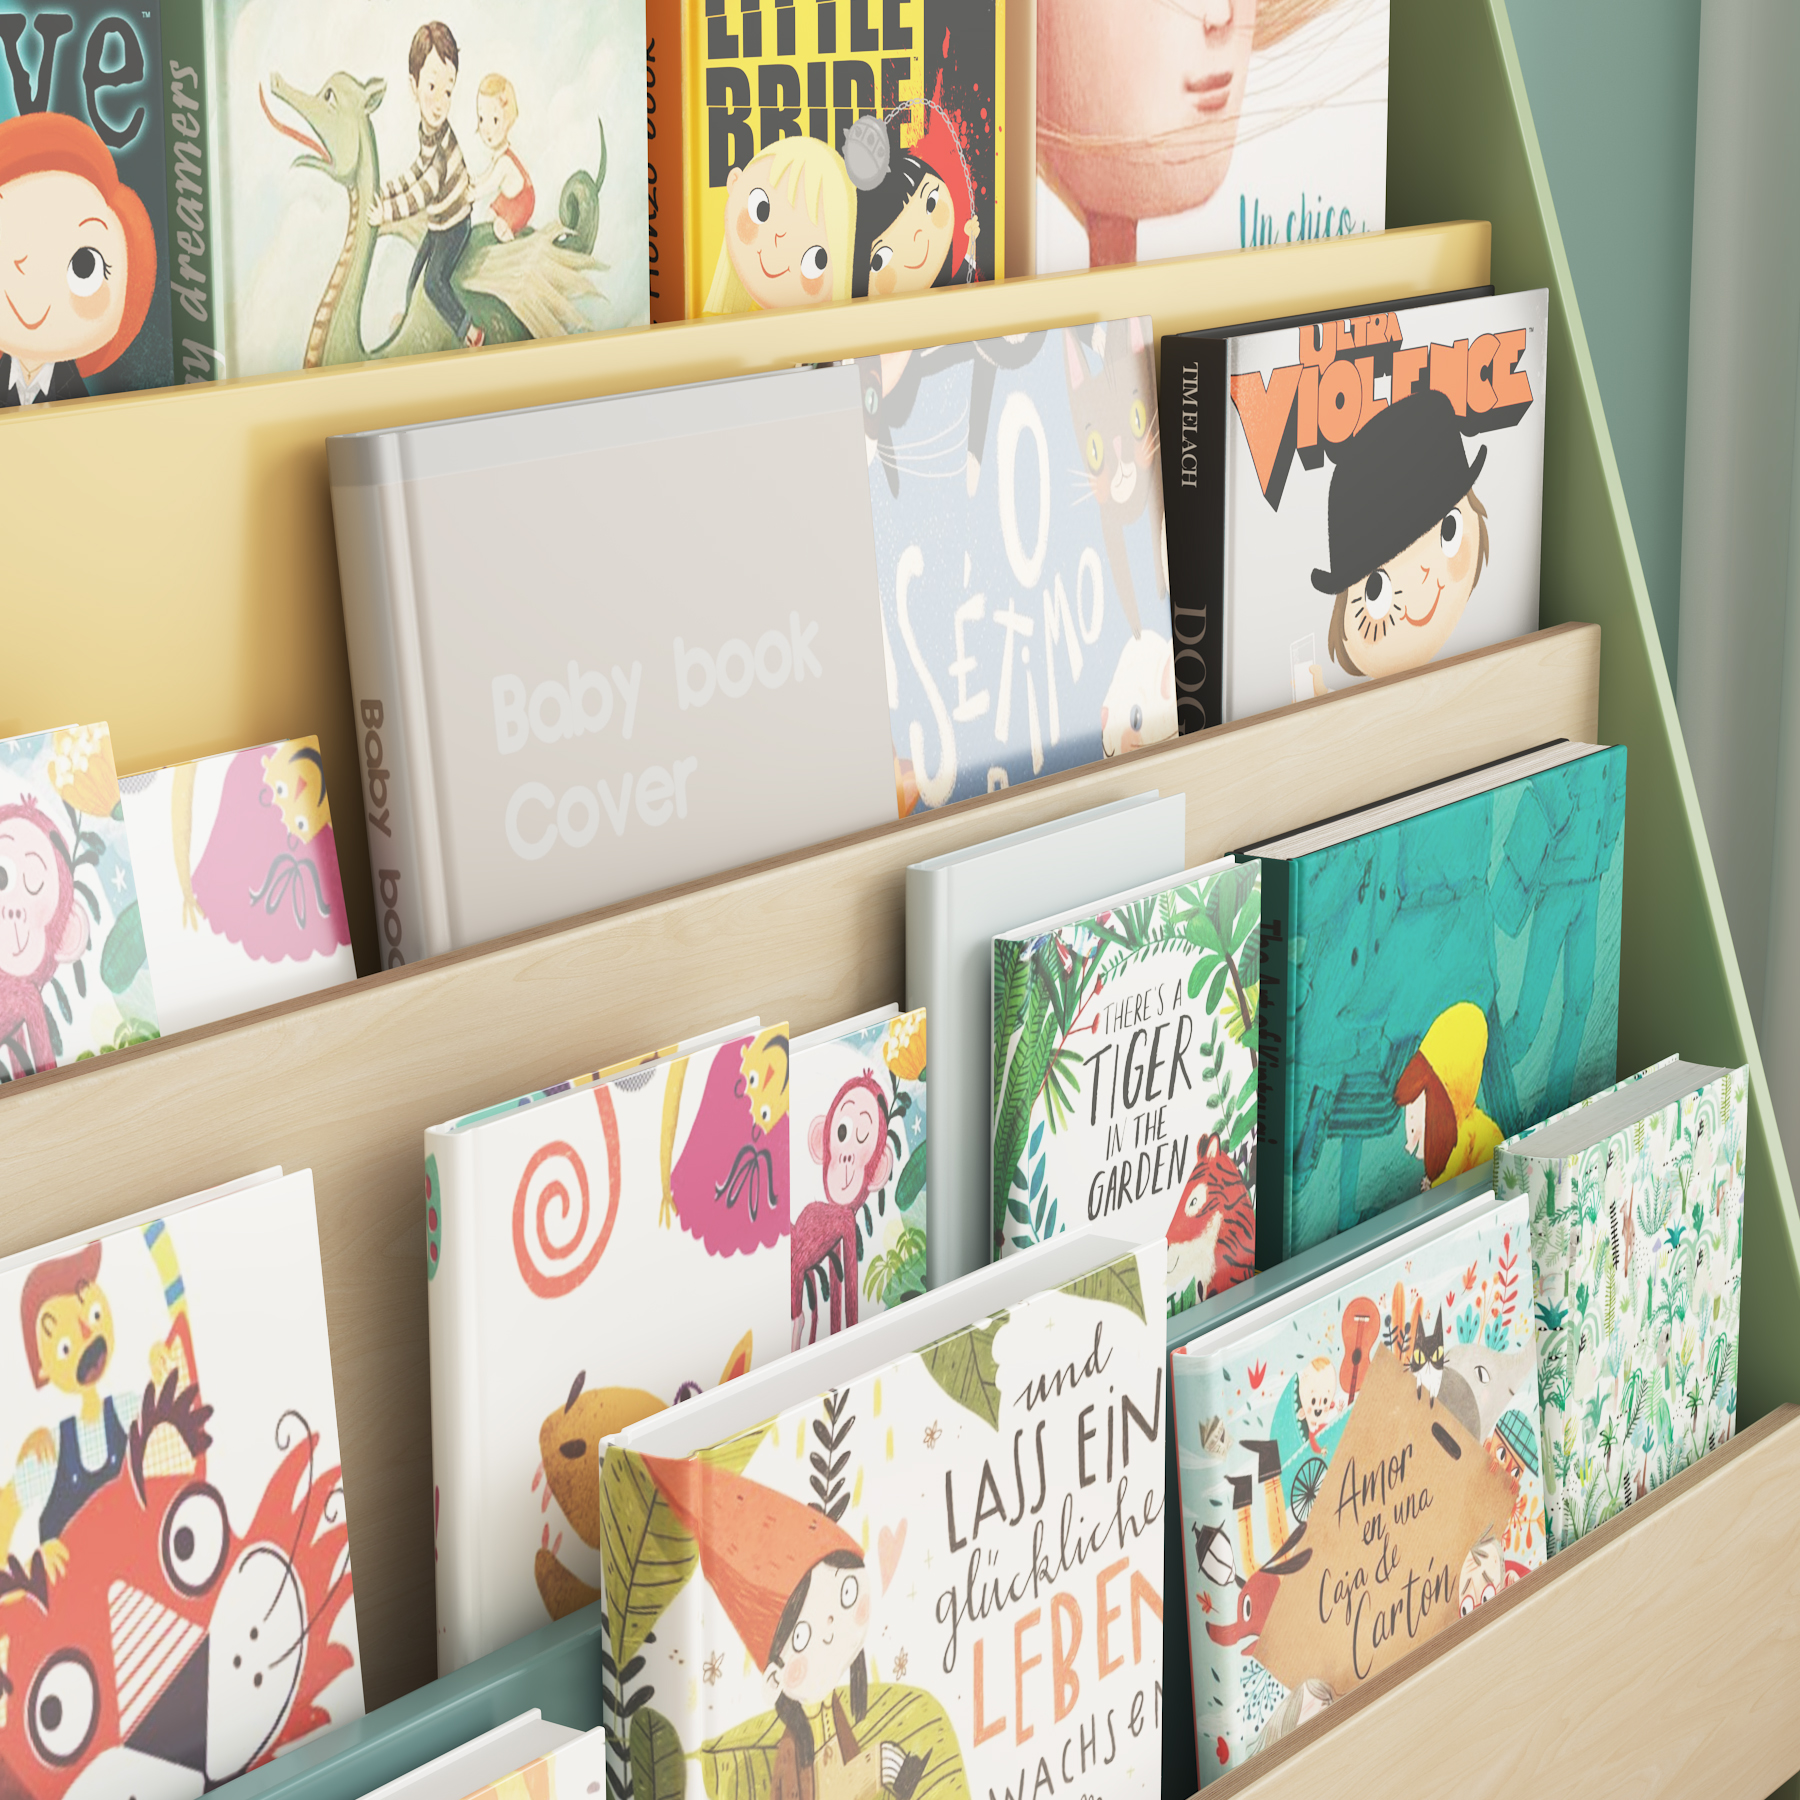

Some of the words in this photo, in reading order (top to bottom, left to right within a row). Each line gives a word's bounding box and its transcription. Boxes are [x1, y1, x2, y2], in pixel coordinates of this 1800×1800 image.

[705, 57, 912, 188] BRIDE
[169, 59, 209, 322] dreamers
[1181, 361, 1200, 408] TIM
[1298, 311, 1404, 374] ULTRA
[1180, 410, 1199, 489] ELACH
[1230, 327, 1535, 497] VIOLENCE
[997, 390, 1051, 589] O
[491, 659, 643, 756] Baby
[672, 610, 824, 712] book
[360, 698, 392, 838] Baby
[504, 755, 699, 862] Cover
[1103, 982, 1166, 1035] THERE'S
[1171, 978, 1183, 1011] A
[1083, 1014, 1193, 1127] TIGER
[1087, 1133, 1189, 1221] GARDEN
[1106, 1116, 1128, 1161] IN
[1133, 1104, 1168, 1149] THE
[1012, 1320, 1114, 1412] und
[945, 1419, 1047, 1554] LASS
[1333, 1442, 1413, 1528] Amor
[1361, 1513, 1387, 1546] en
[1393, 1488, 1434, 1526] una
[935, 1475, 1166, 1674] glückliche
[1318, 1567, 1369, 1627] Caja
[1374, 1531, 1402, 1584] de
[1352, 1556, 1457, 1680] Cartón
